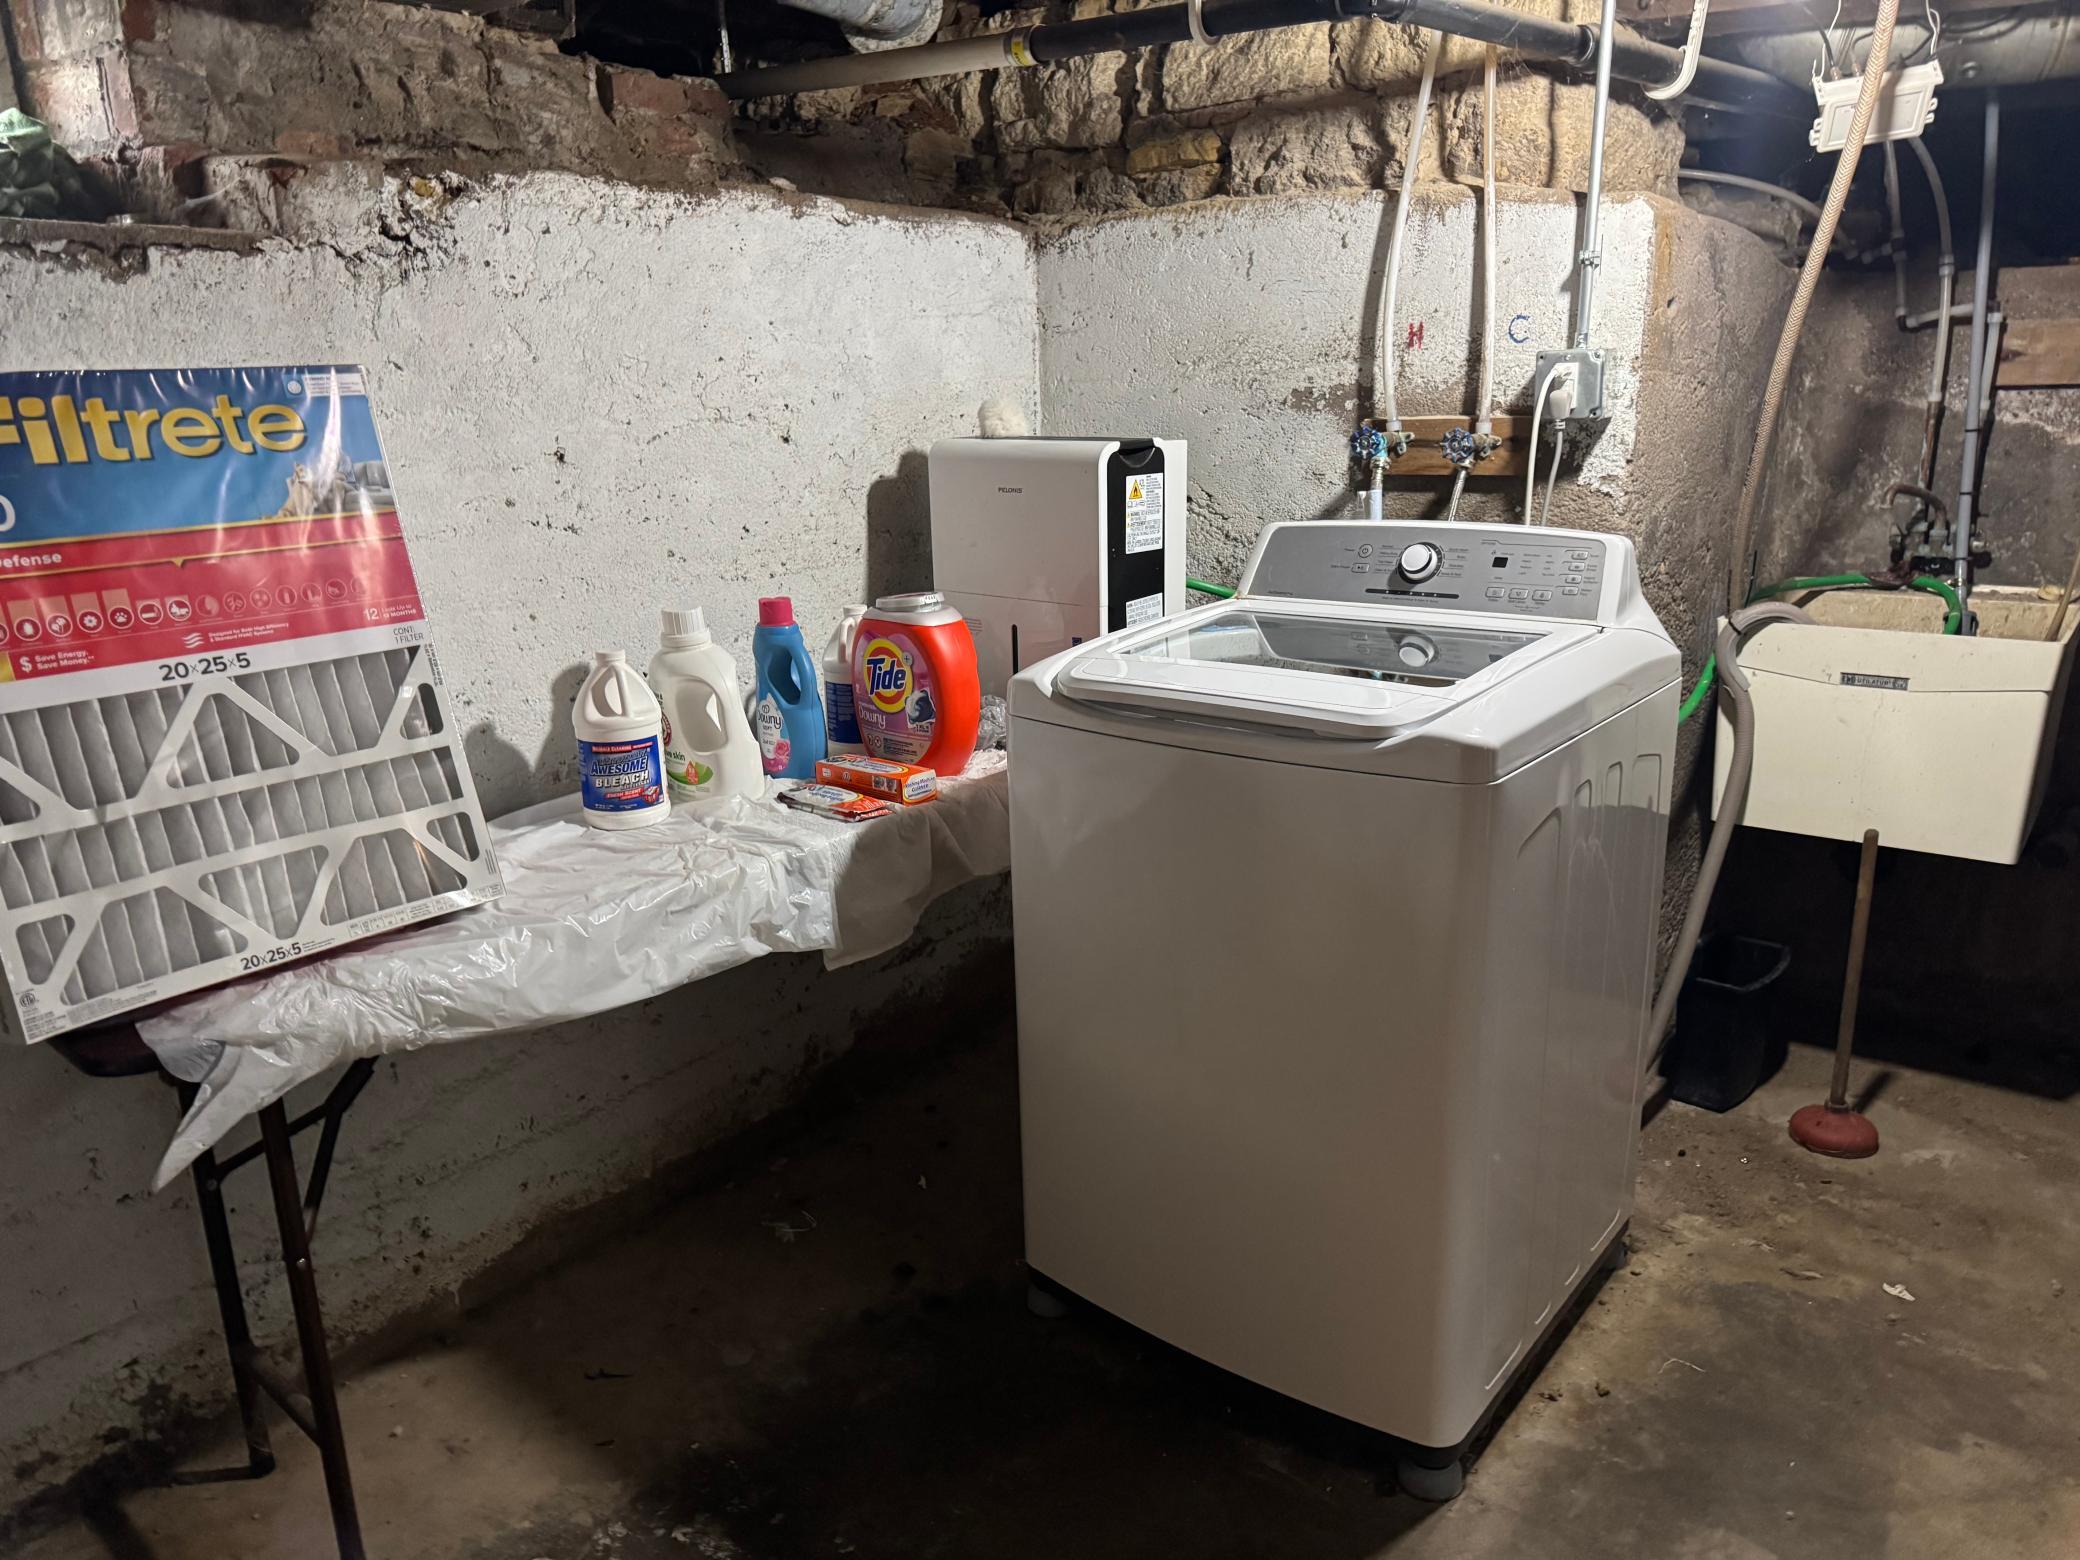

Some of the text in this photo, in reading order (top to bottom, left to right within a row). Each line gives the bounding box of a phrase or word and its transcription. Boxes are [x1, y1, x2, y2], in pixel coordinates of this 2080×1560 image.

[1408, 321, 1424, 350] H
[1508, 314, 1531, 344] C
[0, 553, 62, 569] efense
[400, 633, 424, 644] FILTER
[35, 654, 56, 662] Save
[867, 656, 907, 697] Tide
[591, 756, 648, 776] AWESOME
[595, 770, 650, 788] BLEACH
